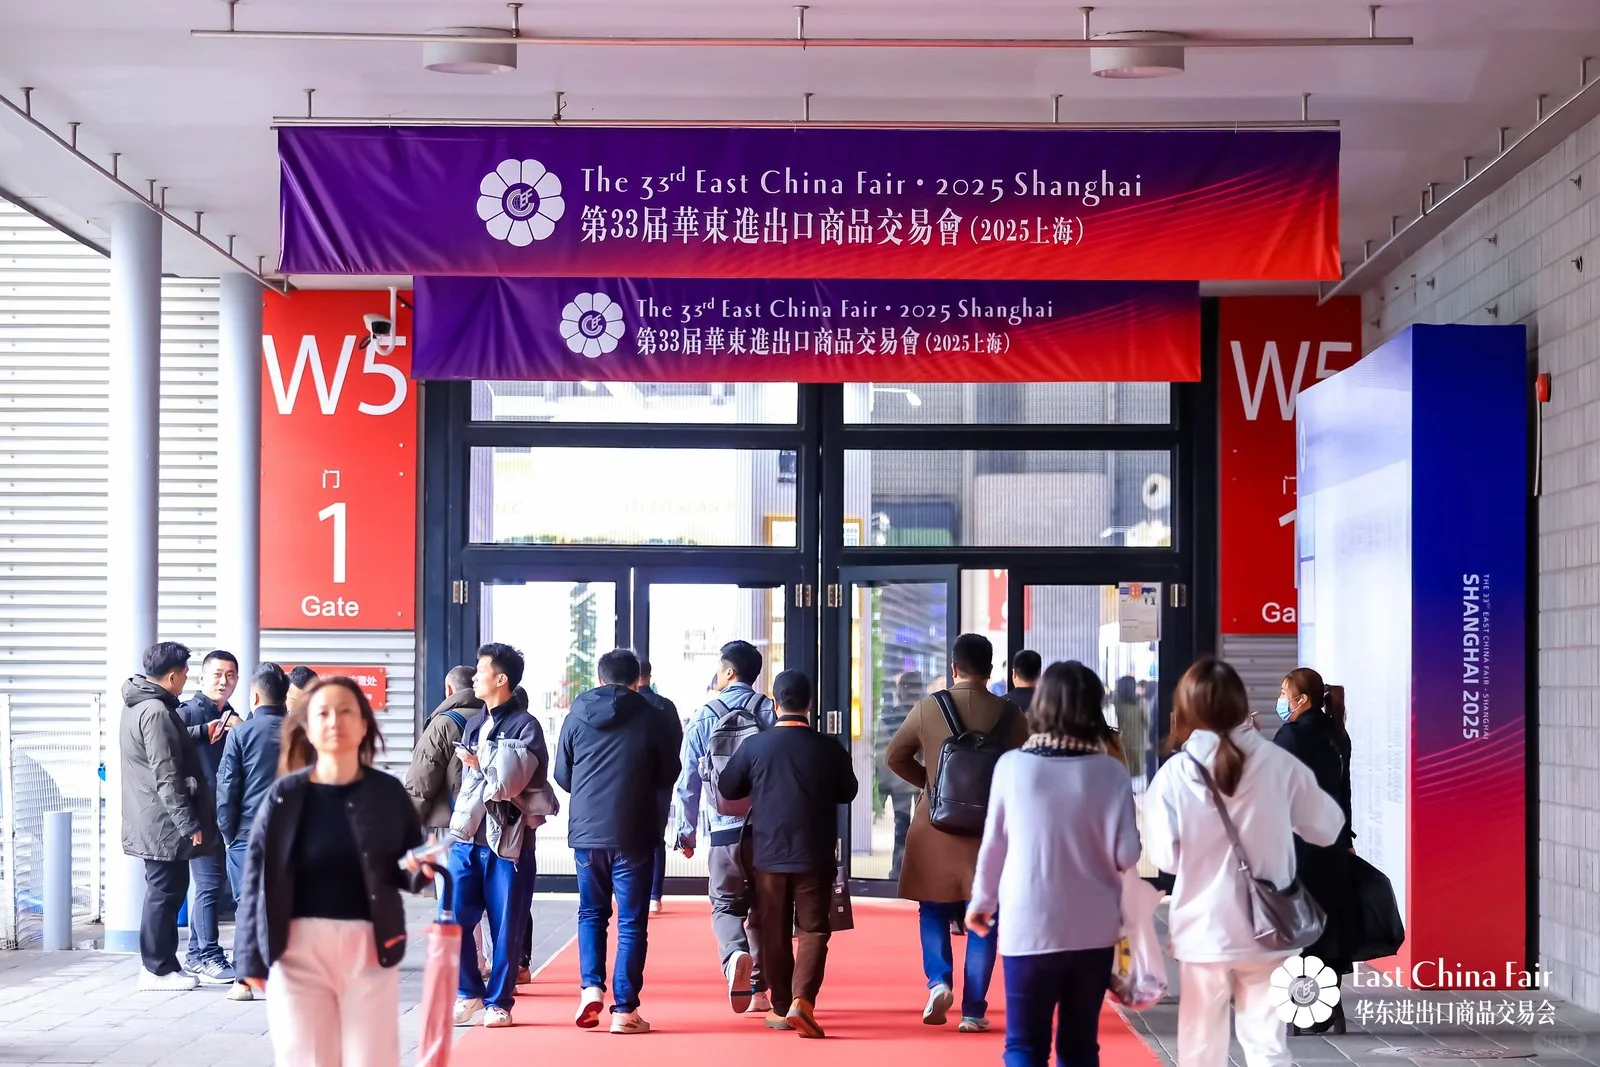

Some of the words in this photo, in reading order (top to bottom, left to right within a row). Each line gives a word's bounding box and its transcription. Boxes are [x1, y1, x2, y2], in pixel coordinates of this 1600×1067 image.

[581, 166, 628, 193] The
[640, 166, 686, 200] 33rd
[697, 170, 749, 194] East
[761, 167, 843, 194] China
[858, 171, 906, 195] Fair
[936, 179, 1004, 203] 2025
[1015, 169, 1141, 207] Shanghai
[637, 297, 672, 318] The
[681, 297, 715, 323] 33rd
[722, 299, 761, 318] East
[770, 297, 831, 318] China
[841, 299, 878, 318] Fair
[900, 305, 951, 323] 2025
[958, 297, 1053, 326] Shanghai
[262, 335, 407, 416] W5
[322, 469, 340, 489] 门
[318, 503, 346, 583] 1
[1482, 574, 1490, 590] THE
[301, 596, 359, 617] Gate
[1462, 574, 1480, 684] SHANGHAI
[1482, 611, 1490, 633] EAST
[1482, 636, 1490, 663] CHINA
[1482, 665, 1490, 685] FAIR
[1462, 690, 1480, 739] 2025
[1482, 693, 1490, 740] SHANGHAI
